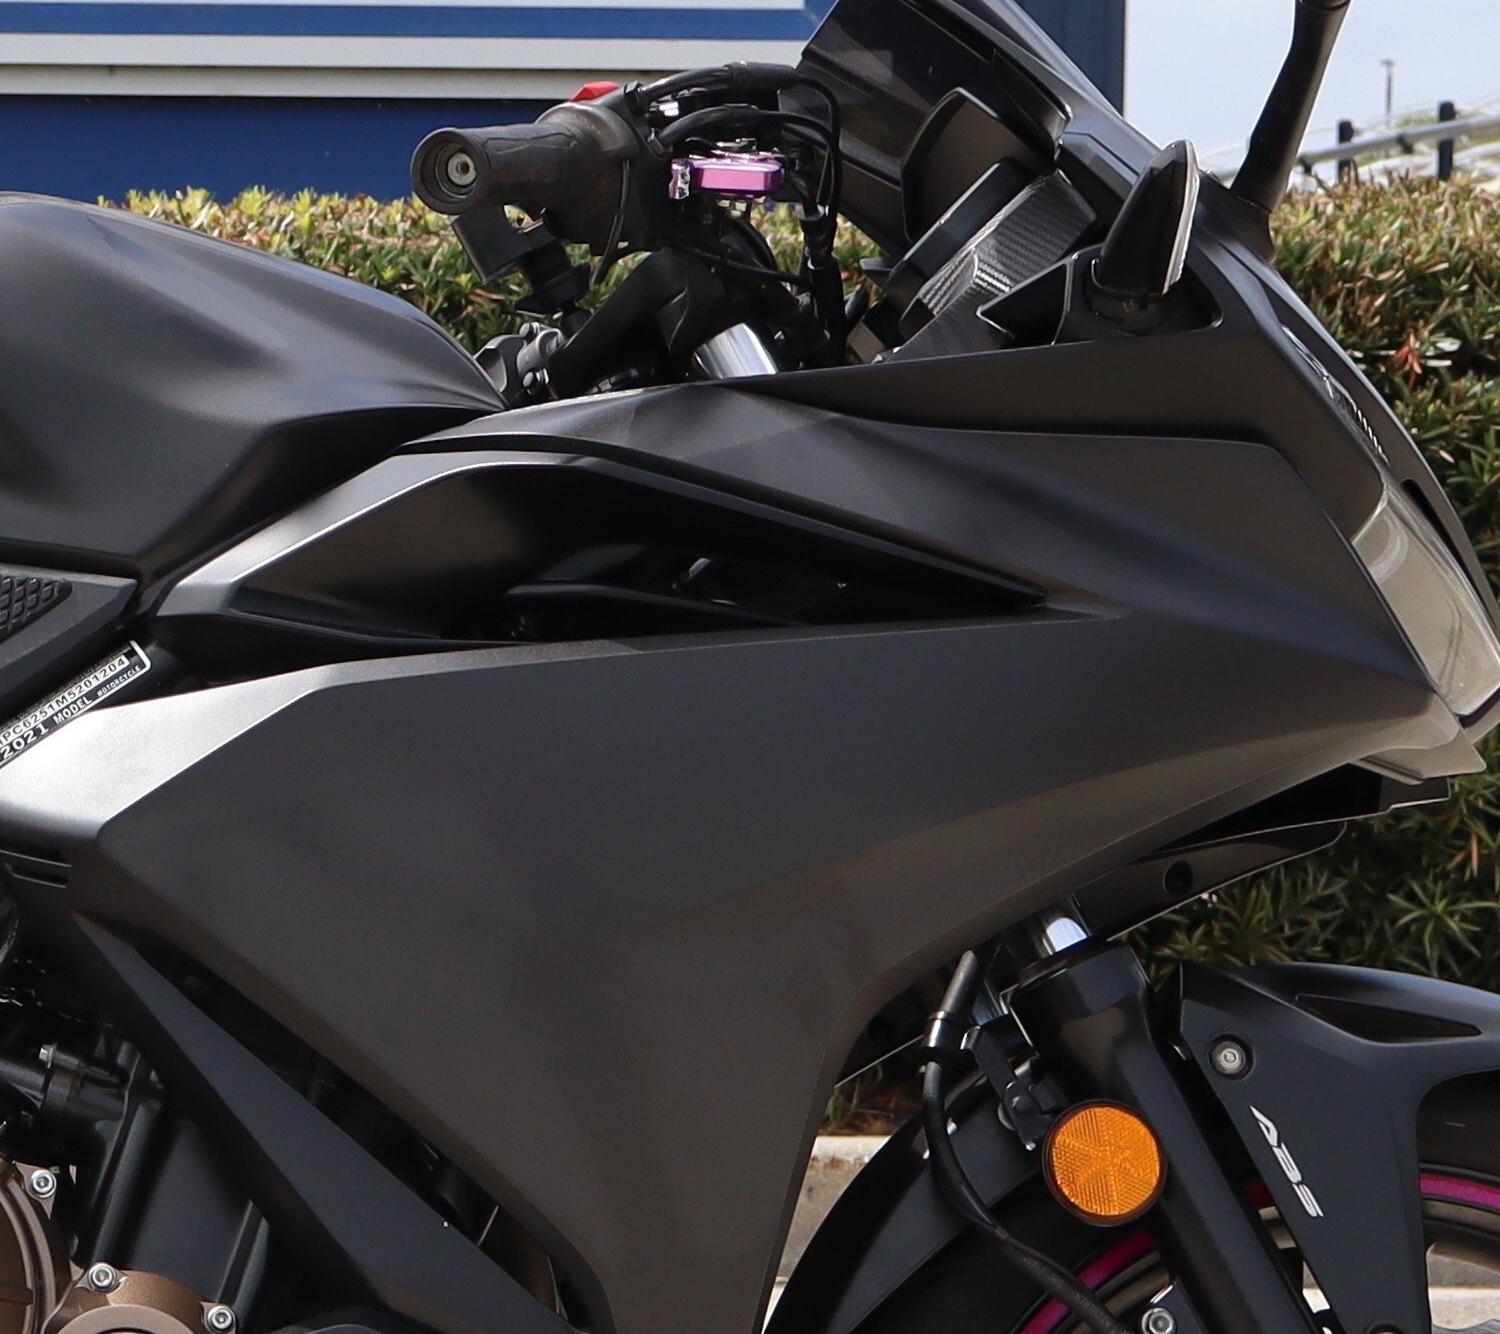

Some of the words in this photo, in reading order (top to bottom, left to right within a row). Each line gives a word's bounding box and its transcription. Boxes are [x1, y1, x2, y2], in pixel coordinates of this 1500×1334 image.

[0, 723, 50, 760] 2021
[52, 696, 93, 726] MODEL
[1249, 1105, 1325, 1218] ABS
